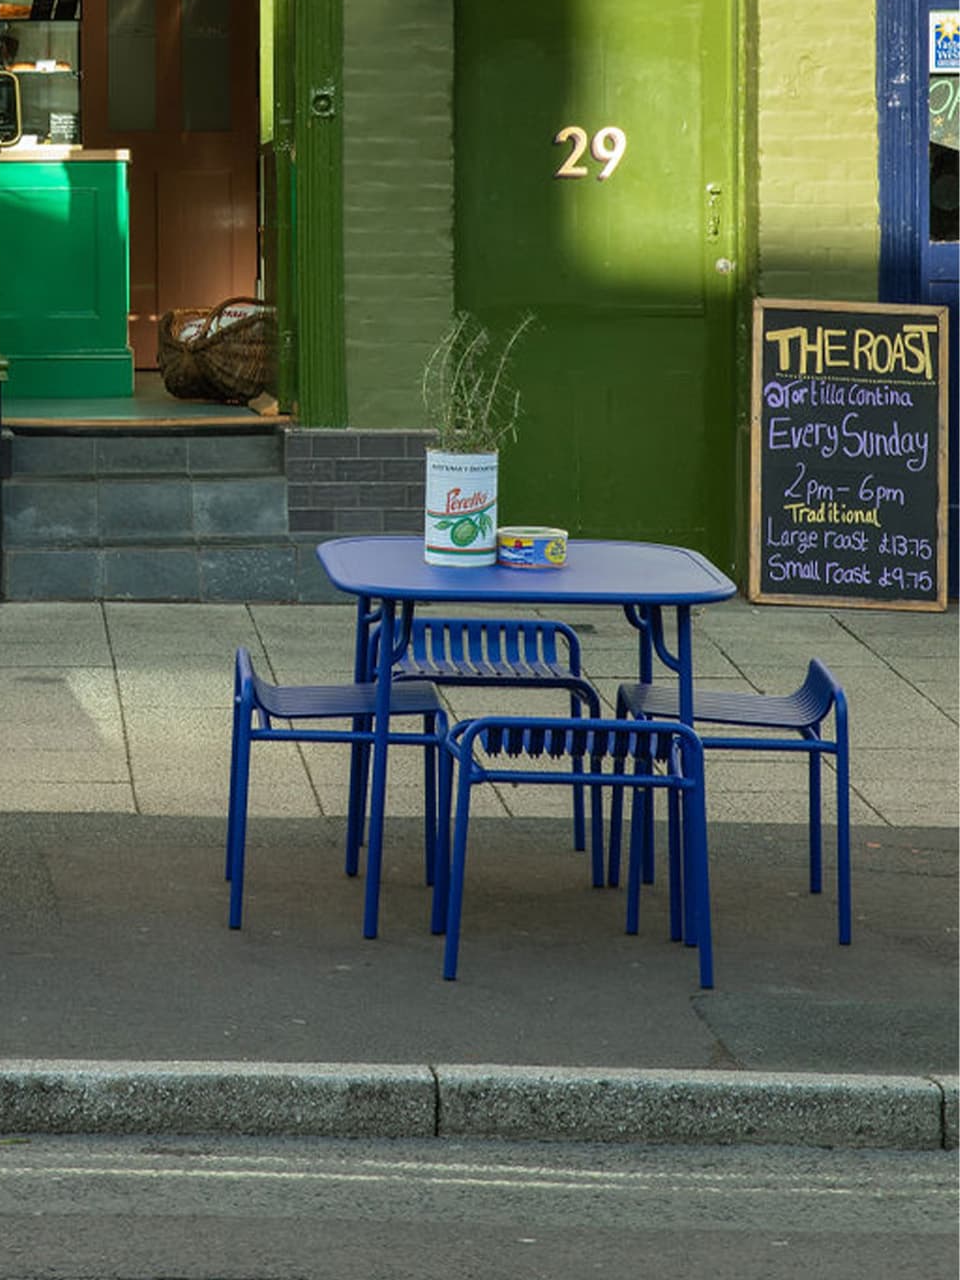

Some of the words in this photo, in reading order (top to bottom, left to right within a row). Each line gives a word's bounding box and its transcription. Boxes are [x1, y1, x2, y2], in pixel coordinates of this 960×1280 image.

[553, 125, 627, 182] 29
[765, 325, 850, 375] THE
[853, 323, 938, 380] ROAST
[769, 417, 839, 459] Every
[842, 412, 929, 472] Sunday
[858, 474, 905, 508] 6pm
[783, 502, 882, 528] Traditional
[767, 516, 818, 554] Large
[824, 530, 869, 552] roast
[878, 533, 933, 560] £13.75
[768, 553, 820, 581] Small
[825, 563, 871, 585] roast
[878, 567, 933, 592] £9.75
